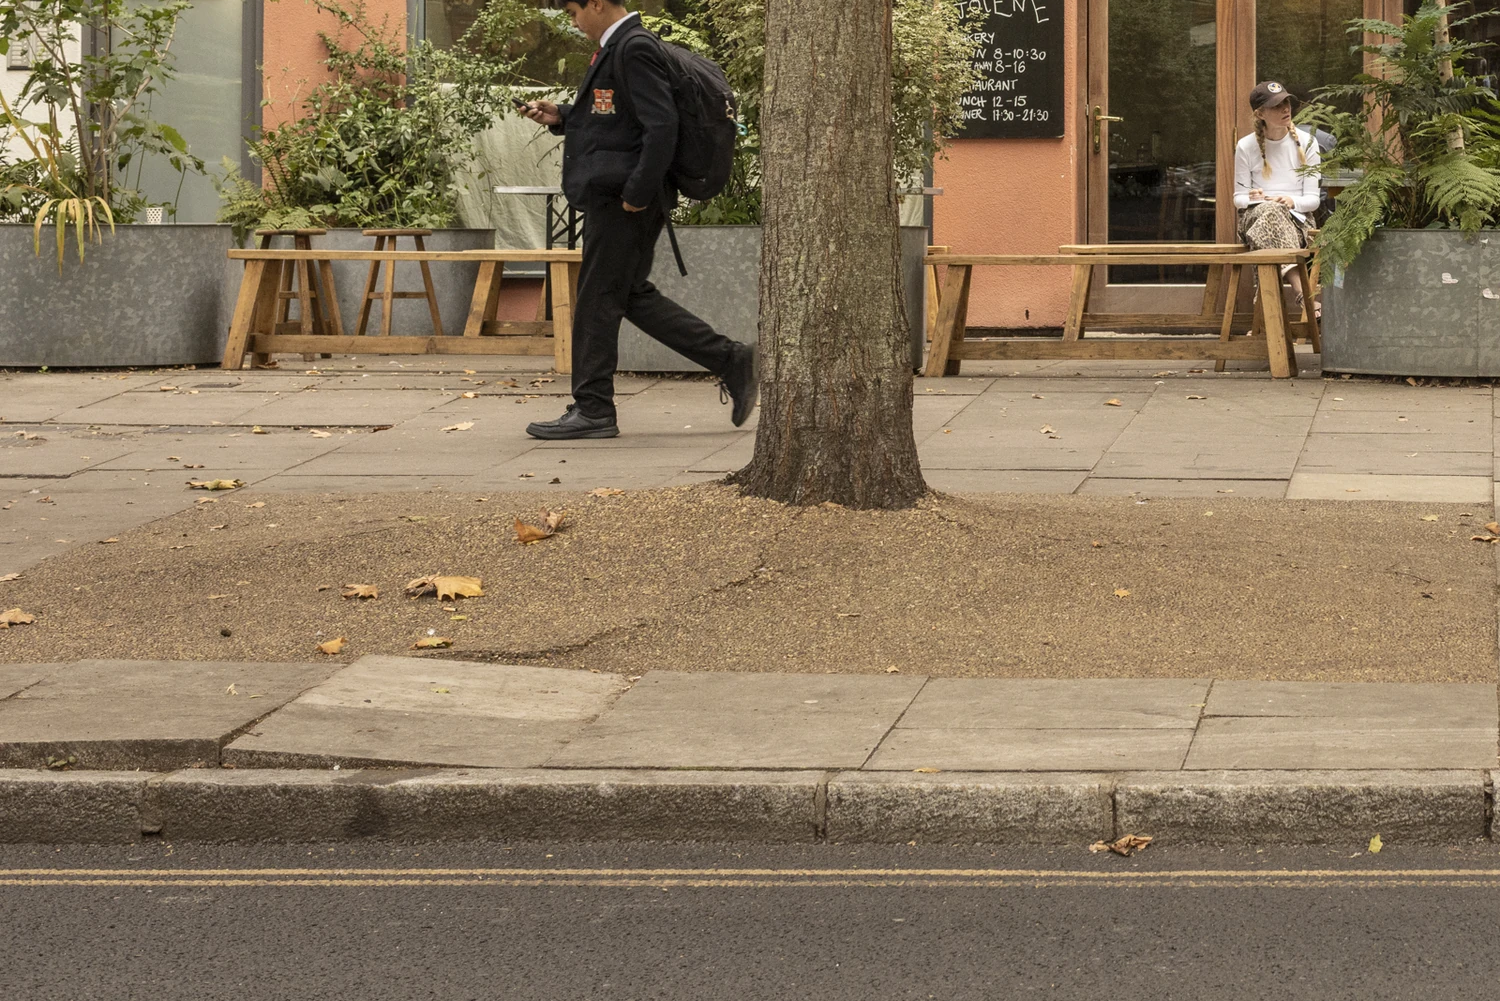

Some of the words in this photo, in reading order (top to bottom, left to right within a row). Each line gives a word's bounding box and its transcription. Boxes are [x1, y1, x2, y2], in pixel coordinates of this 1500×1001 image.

[962, 32, 995, 44] KERY
[974, 61, 993, 72] AWAY
[970, 79, 1018, 91] TAURANT
[955, 96, 987, 107] UNCH
